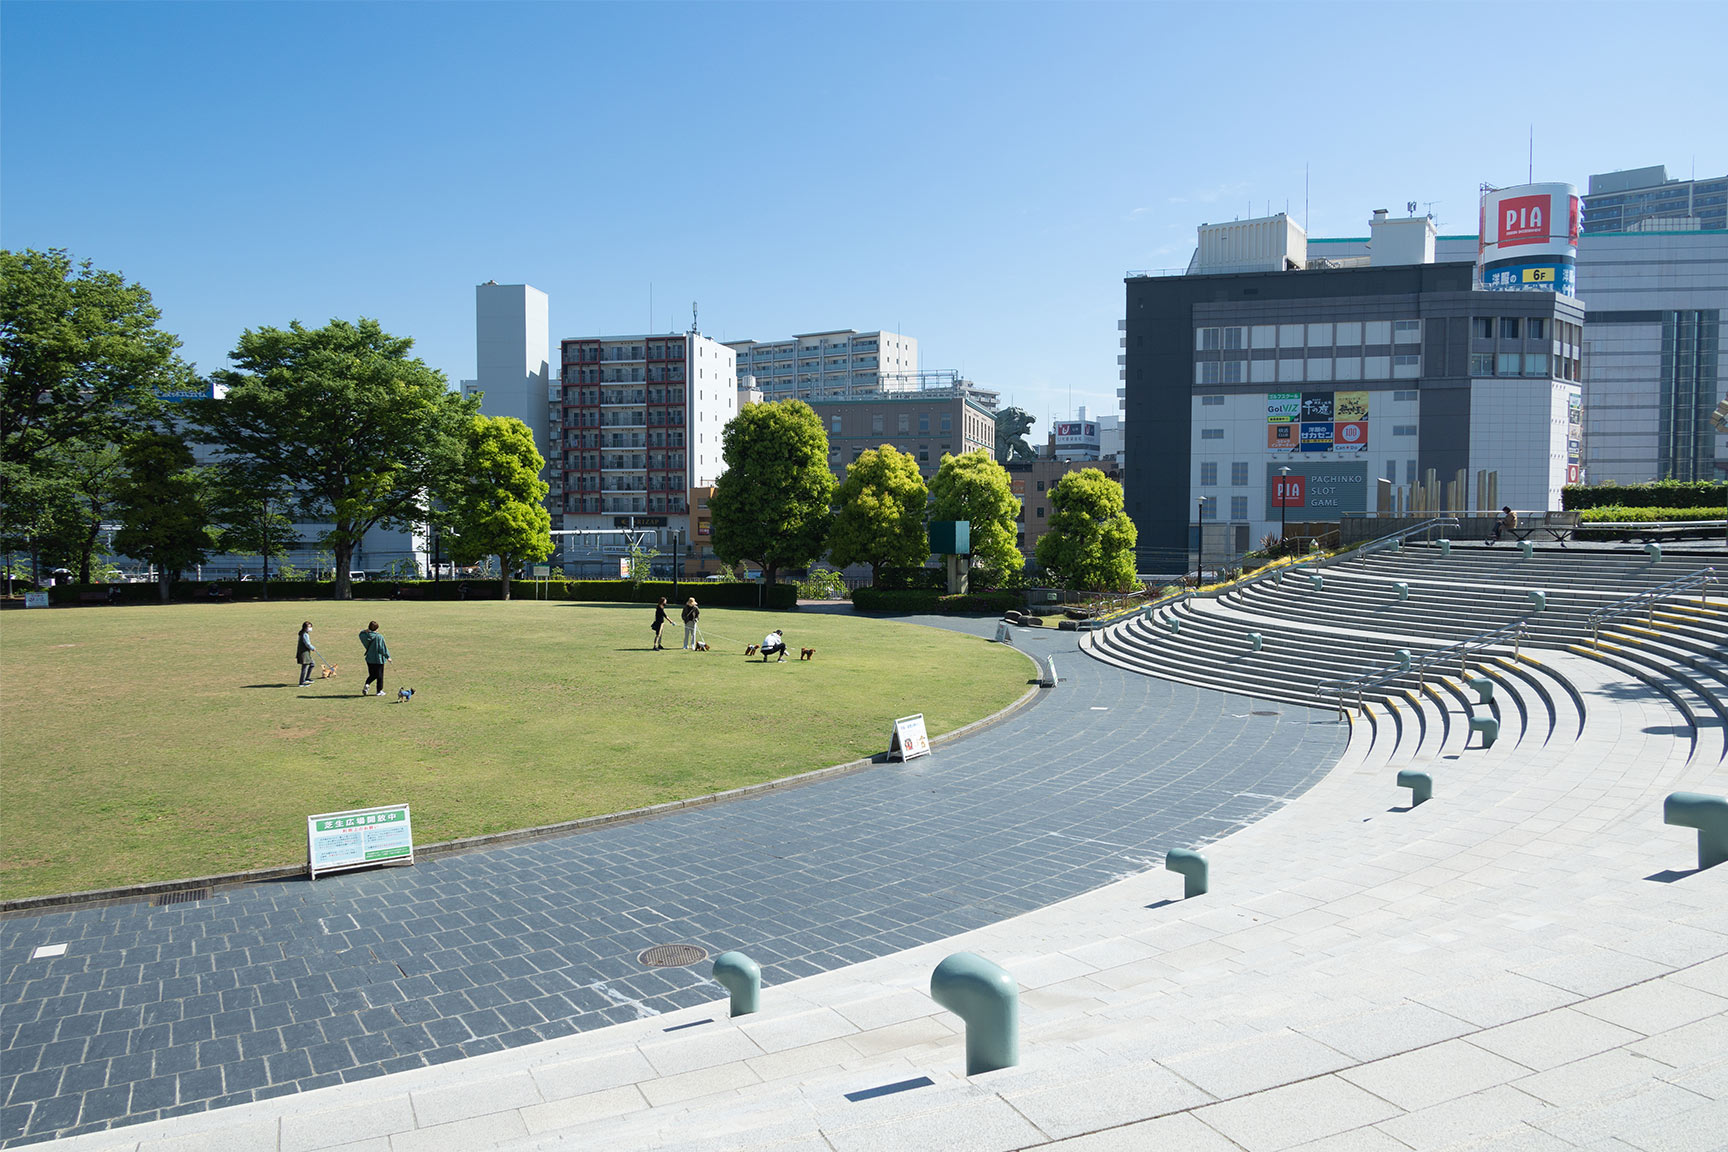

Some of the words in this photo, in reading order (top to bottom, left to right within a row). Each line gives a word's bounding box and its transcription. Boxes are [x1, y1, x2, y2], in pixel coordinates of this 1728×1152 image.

[1506, 206, 1542, 231] PIA
[1533, 269, 1546, 281] 6F
[1311, 475, 1362, 483] PACHINKO
[1278, 483, 1299, 496] PIA
[1311, 487, 1336, 495] SLOT
